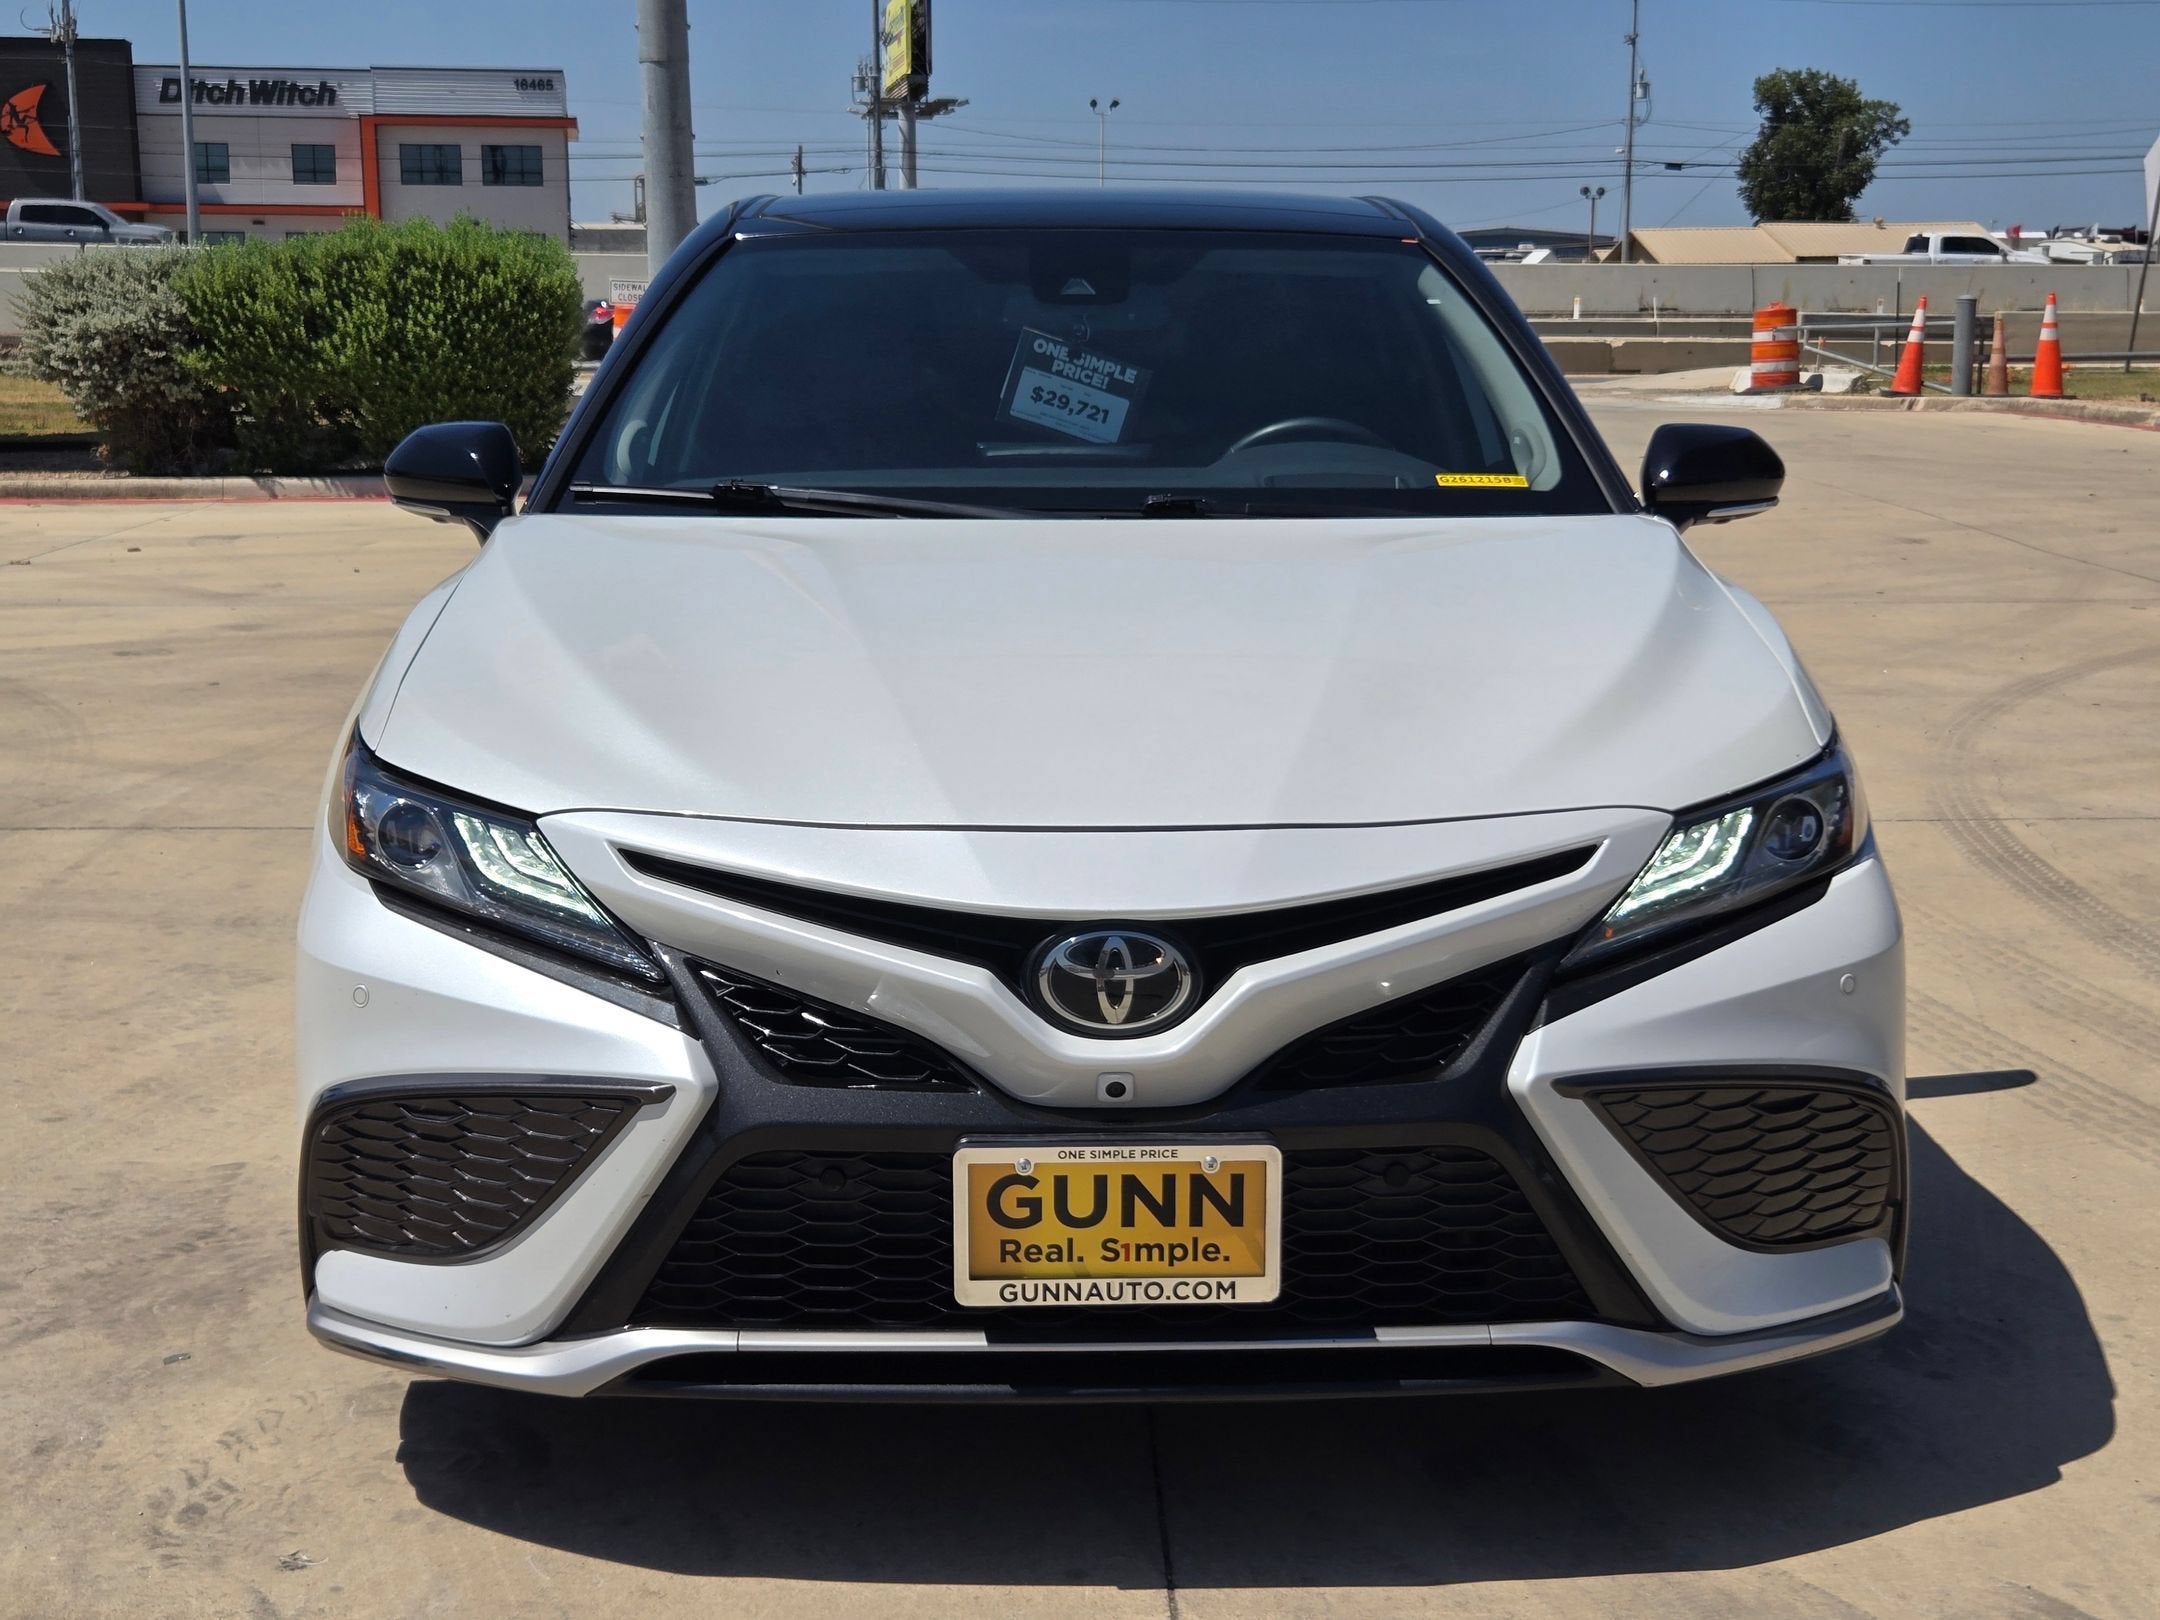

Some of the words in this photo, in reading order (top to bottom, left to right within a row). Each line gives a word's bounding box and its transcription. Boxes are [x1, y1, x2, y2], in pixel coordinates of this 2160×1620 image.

[249, 80, 337, 106] Witch
[613, 283, 646, 291] SIDEWAL
[618, 294, 643, 302] CLOS
[1033, 339, 1069, 361] ONE
[1052, 359, 1110, 389] PRICE!
[1030, 386, 1110, 424] $29,721
[1058, 1150, 1085, 1159] ONE
[1090, 1150, 1137, 1159] SIMPLE
[1140, 1149, 1179, 1159] PRICE
[986, 1173, 1245, 1229] GUNN
[999, 1237, 1084, 1263] Real.
[999, 1281, 1237, 1303] GUNNAUTO.COM
